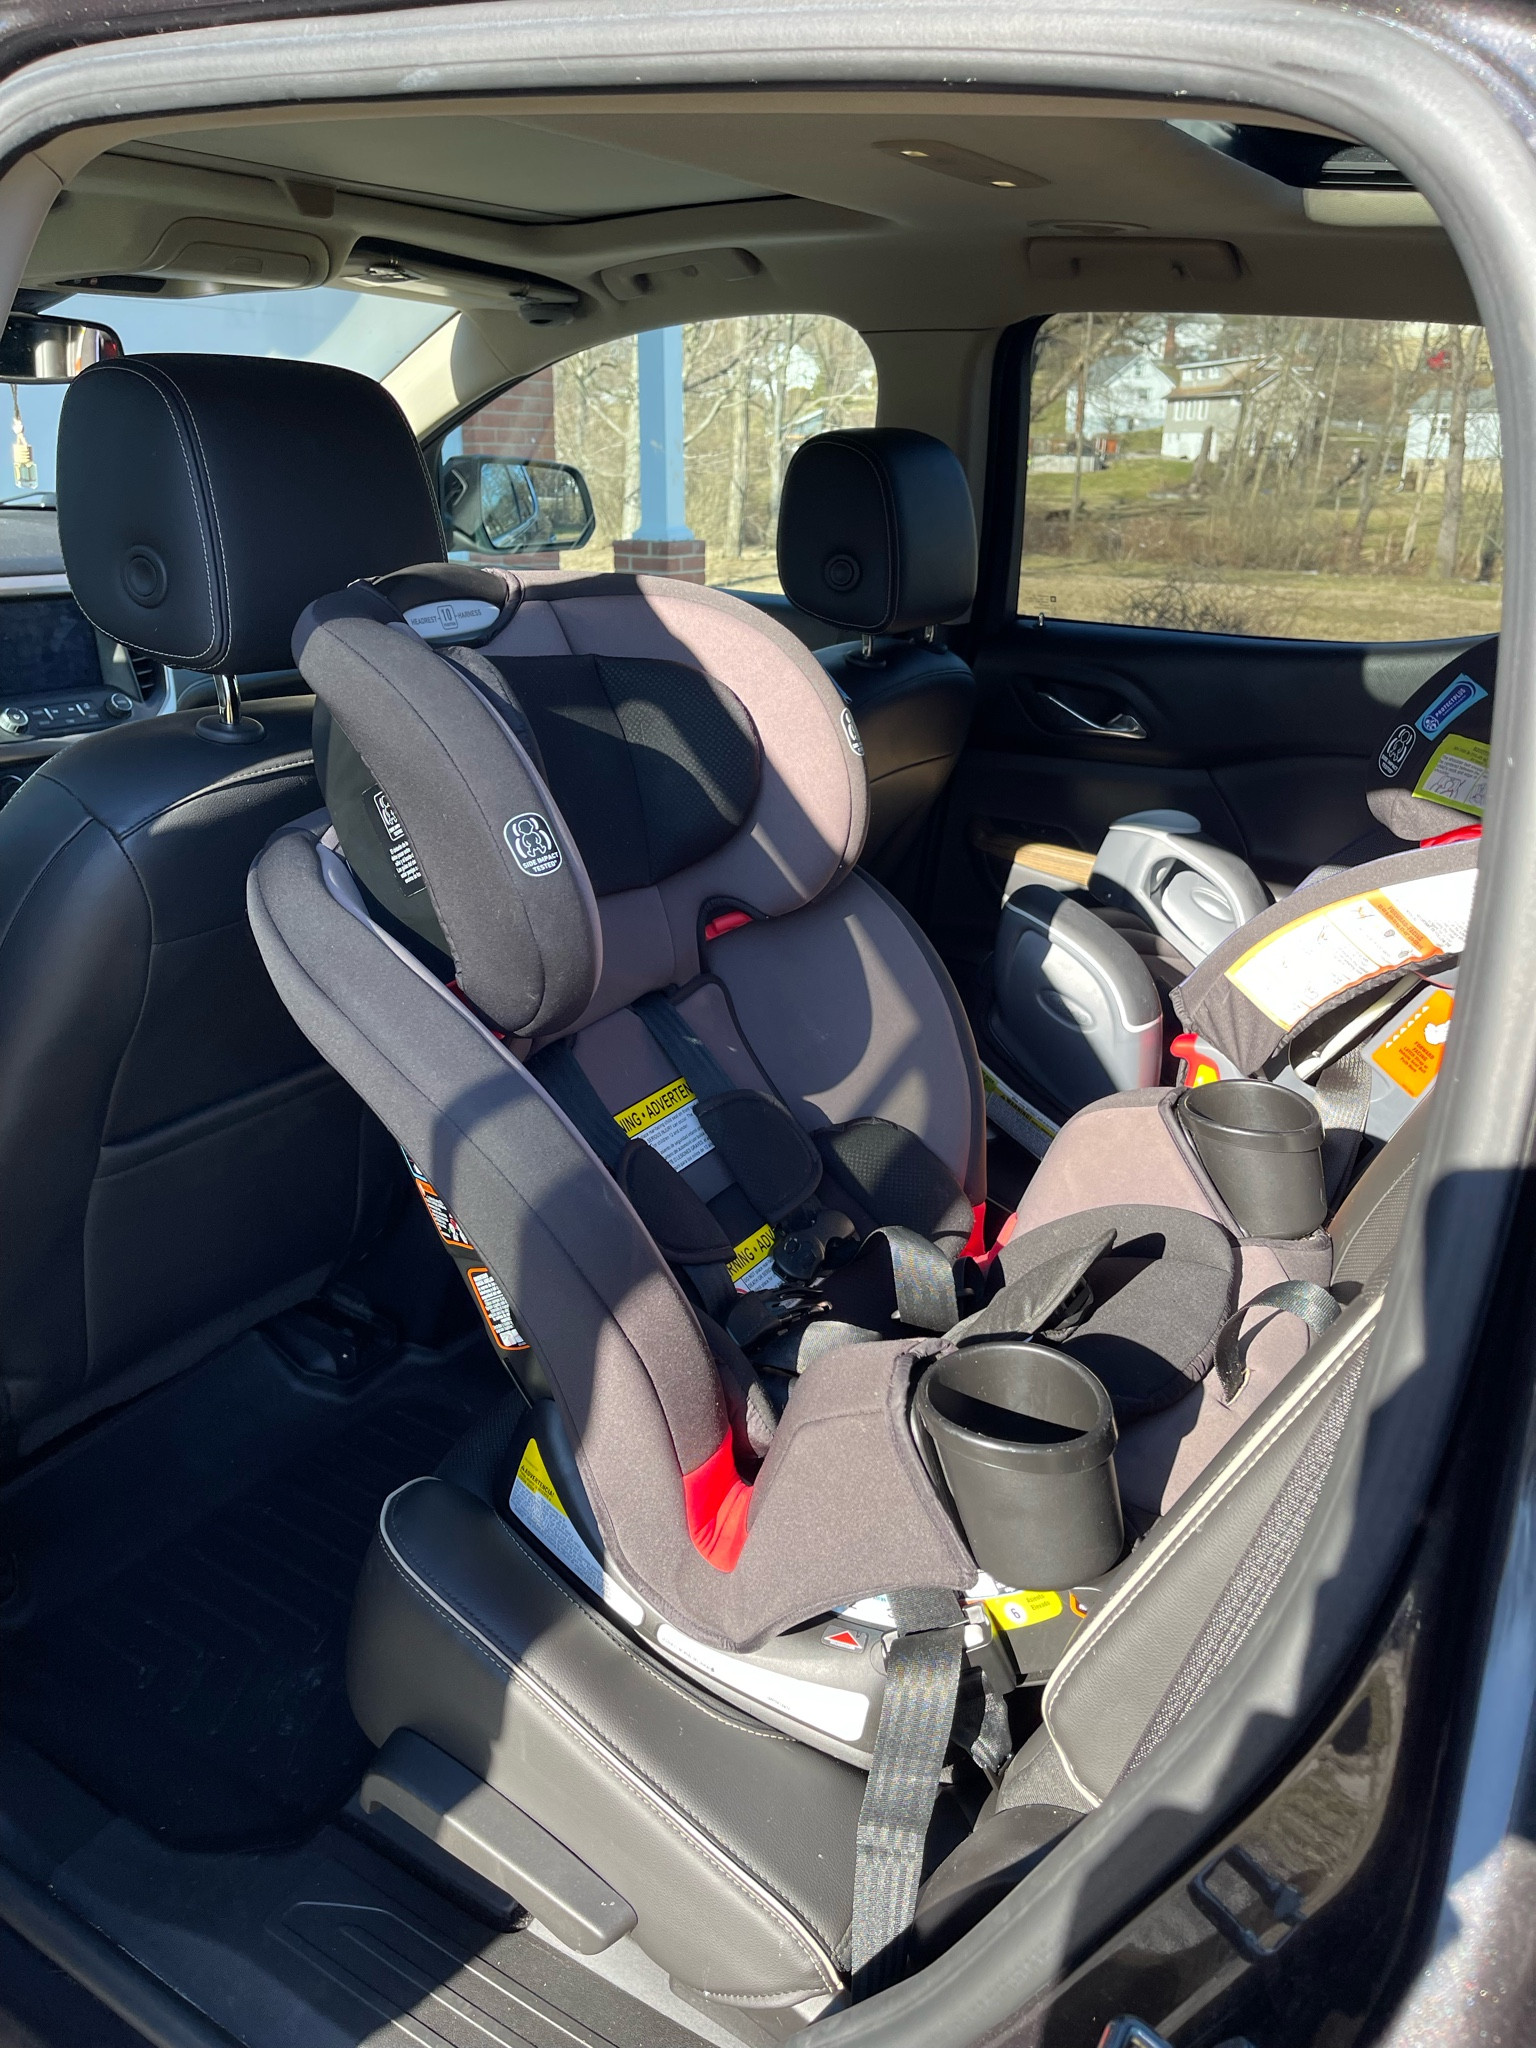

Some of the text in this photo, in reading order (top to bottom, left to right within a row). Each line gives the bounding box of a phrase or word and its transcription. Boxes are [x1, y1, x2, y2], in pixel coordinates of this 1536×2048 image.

[410, 616, 437, 625] HEADREST
[441, 608, 453, 622] 10
[458, 609, 482, 619] HARNESS
[1435, 688, 1466, 718] PROTECTPLUS
[522, 852, 558, 869] SIDE IMPACT
[1010, 1607, 1020, 1619] 6
